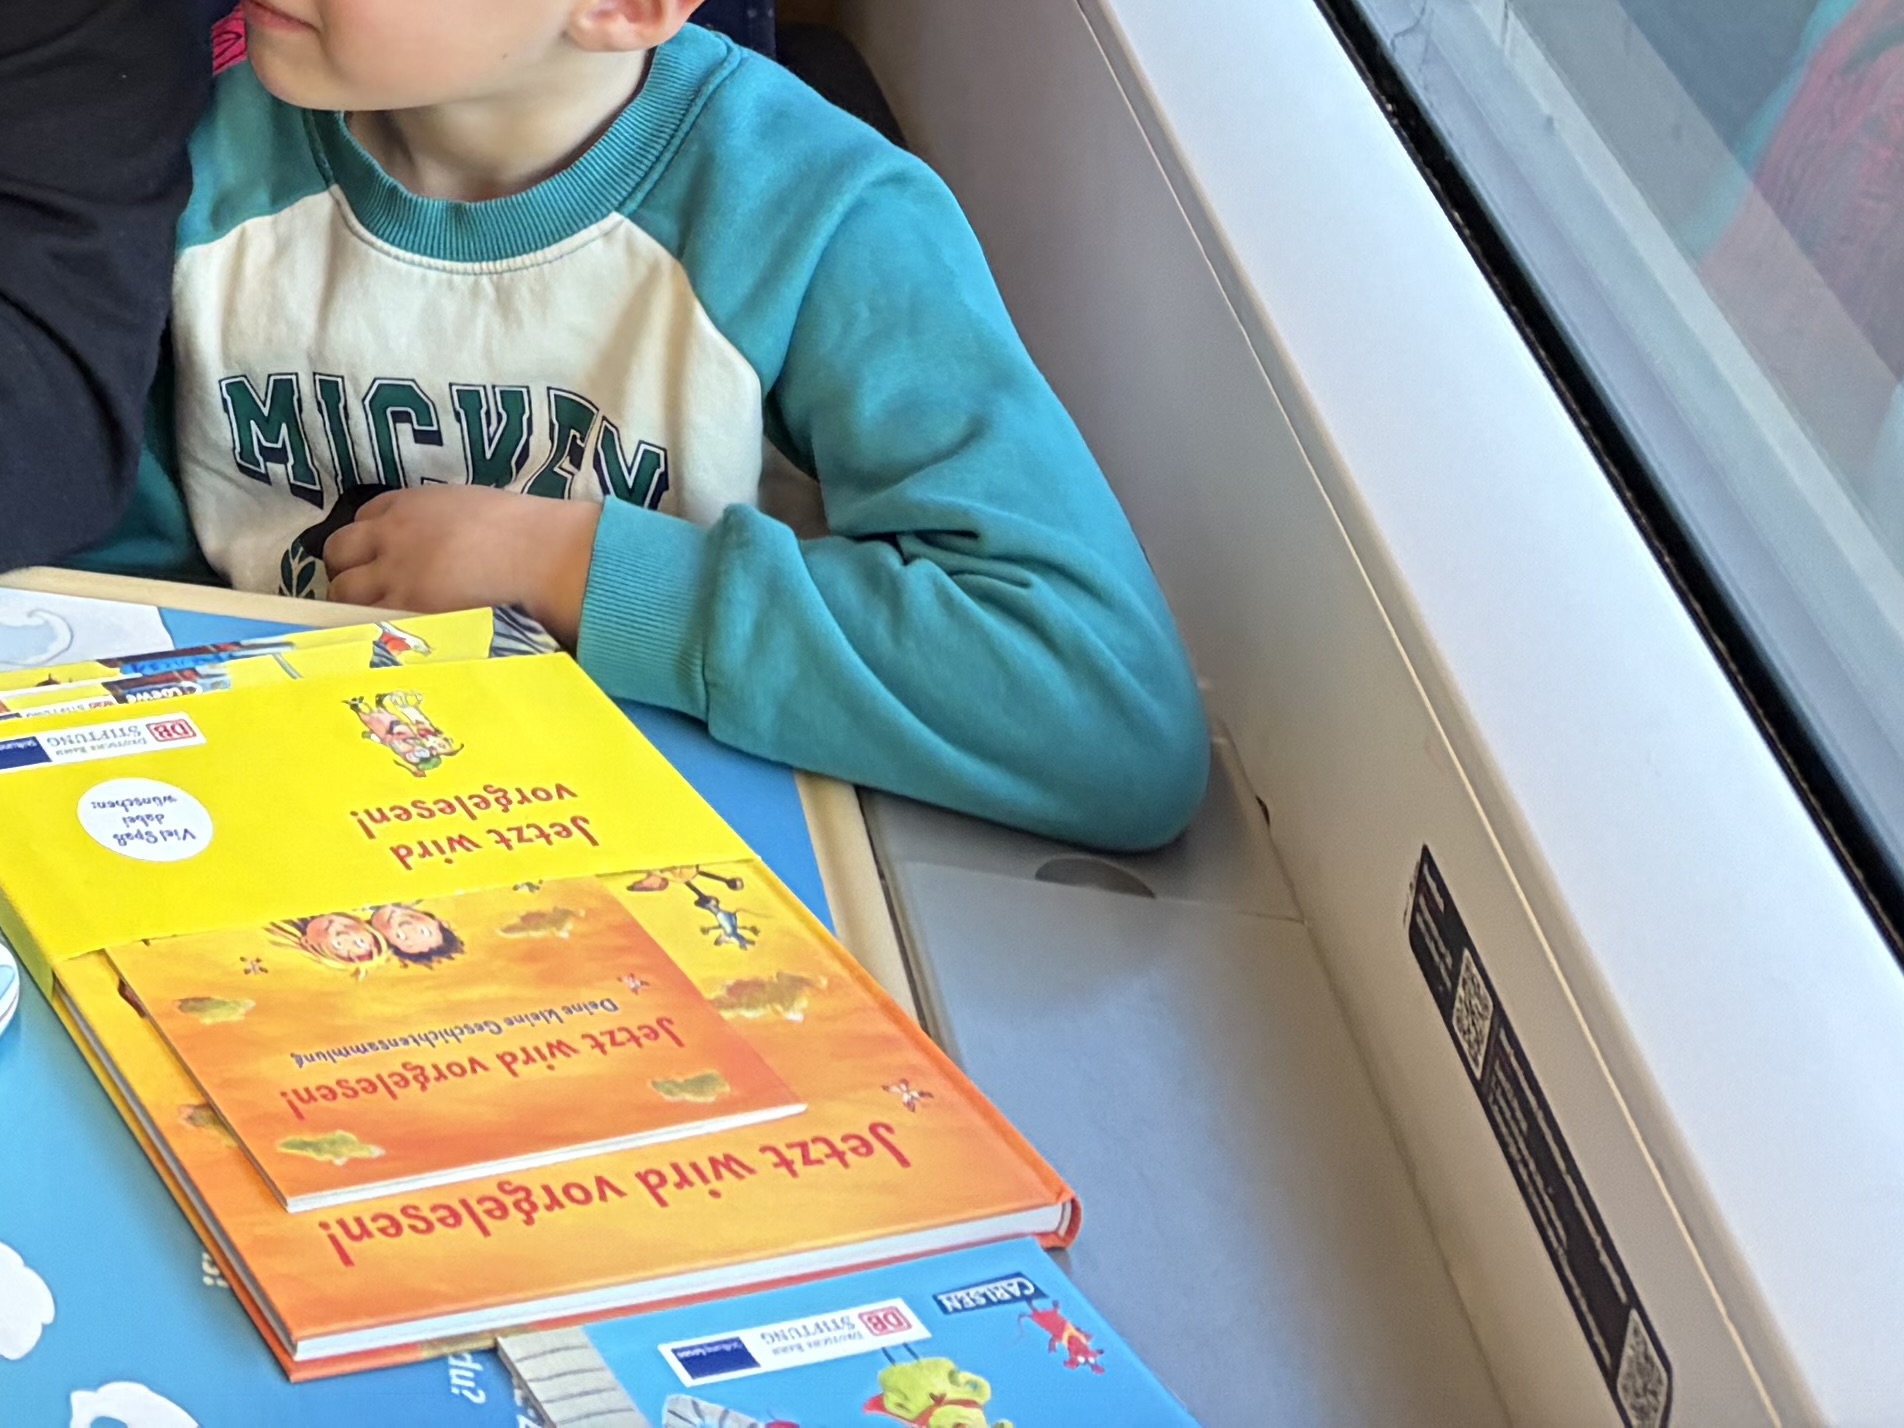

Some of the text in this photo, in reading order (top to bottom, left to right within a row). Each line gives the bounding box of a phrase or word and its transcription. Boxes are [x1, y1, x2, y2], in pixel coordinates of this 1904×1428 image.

[217, 373, 668, 510] MICKEY
[46, 724, 142, 748] STIFTUNG
[113, 827, 196, 846] Viel Spaß
[122, 813, 165, 828] dabei
[349, 783, 578, 840] vorgelesen!
[390, 815, 600, 871] Jetzt wird
[290, 997, 620, 1070] Deine kleine Geschichtensammlung
[280, 1016, 687, 1121] Jetzt wird vorgelesen!
[318, 1121, 913, 1268] Jetzt wird vorgelesen!
[937, 1276, 1036, 1312] CARLSEN
[760, 1315, 856, 1346] STIFTUNG
